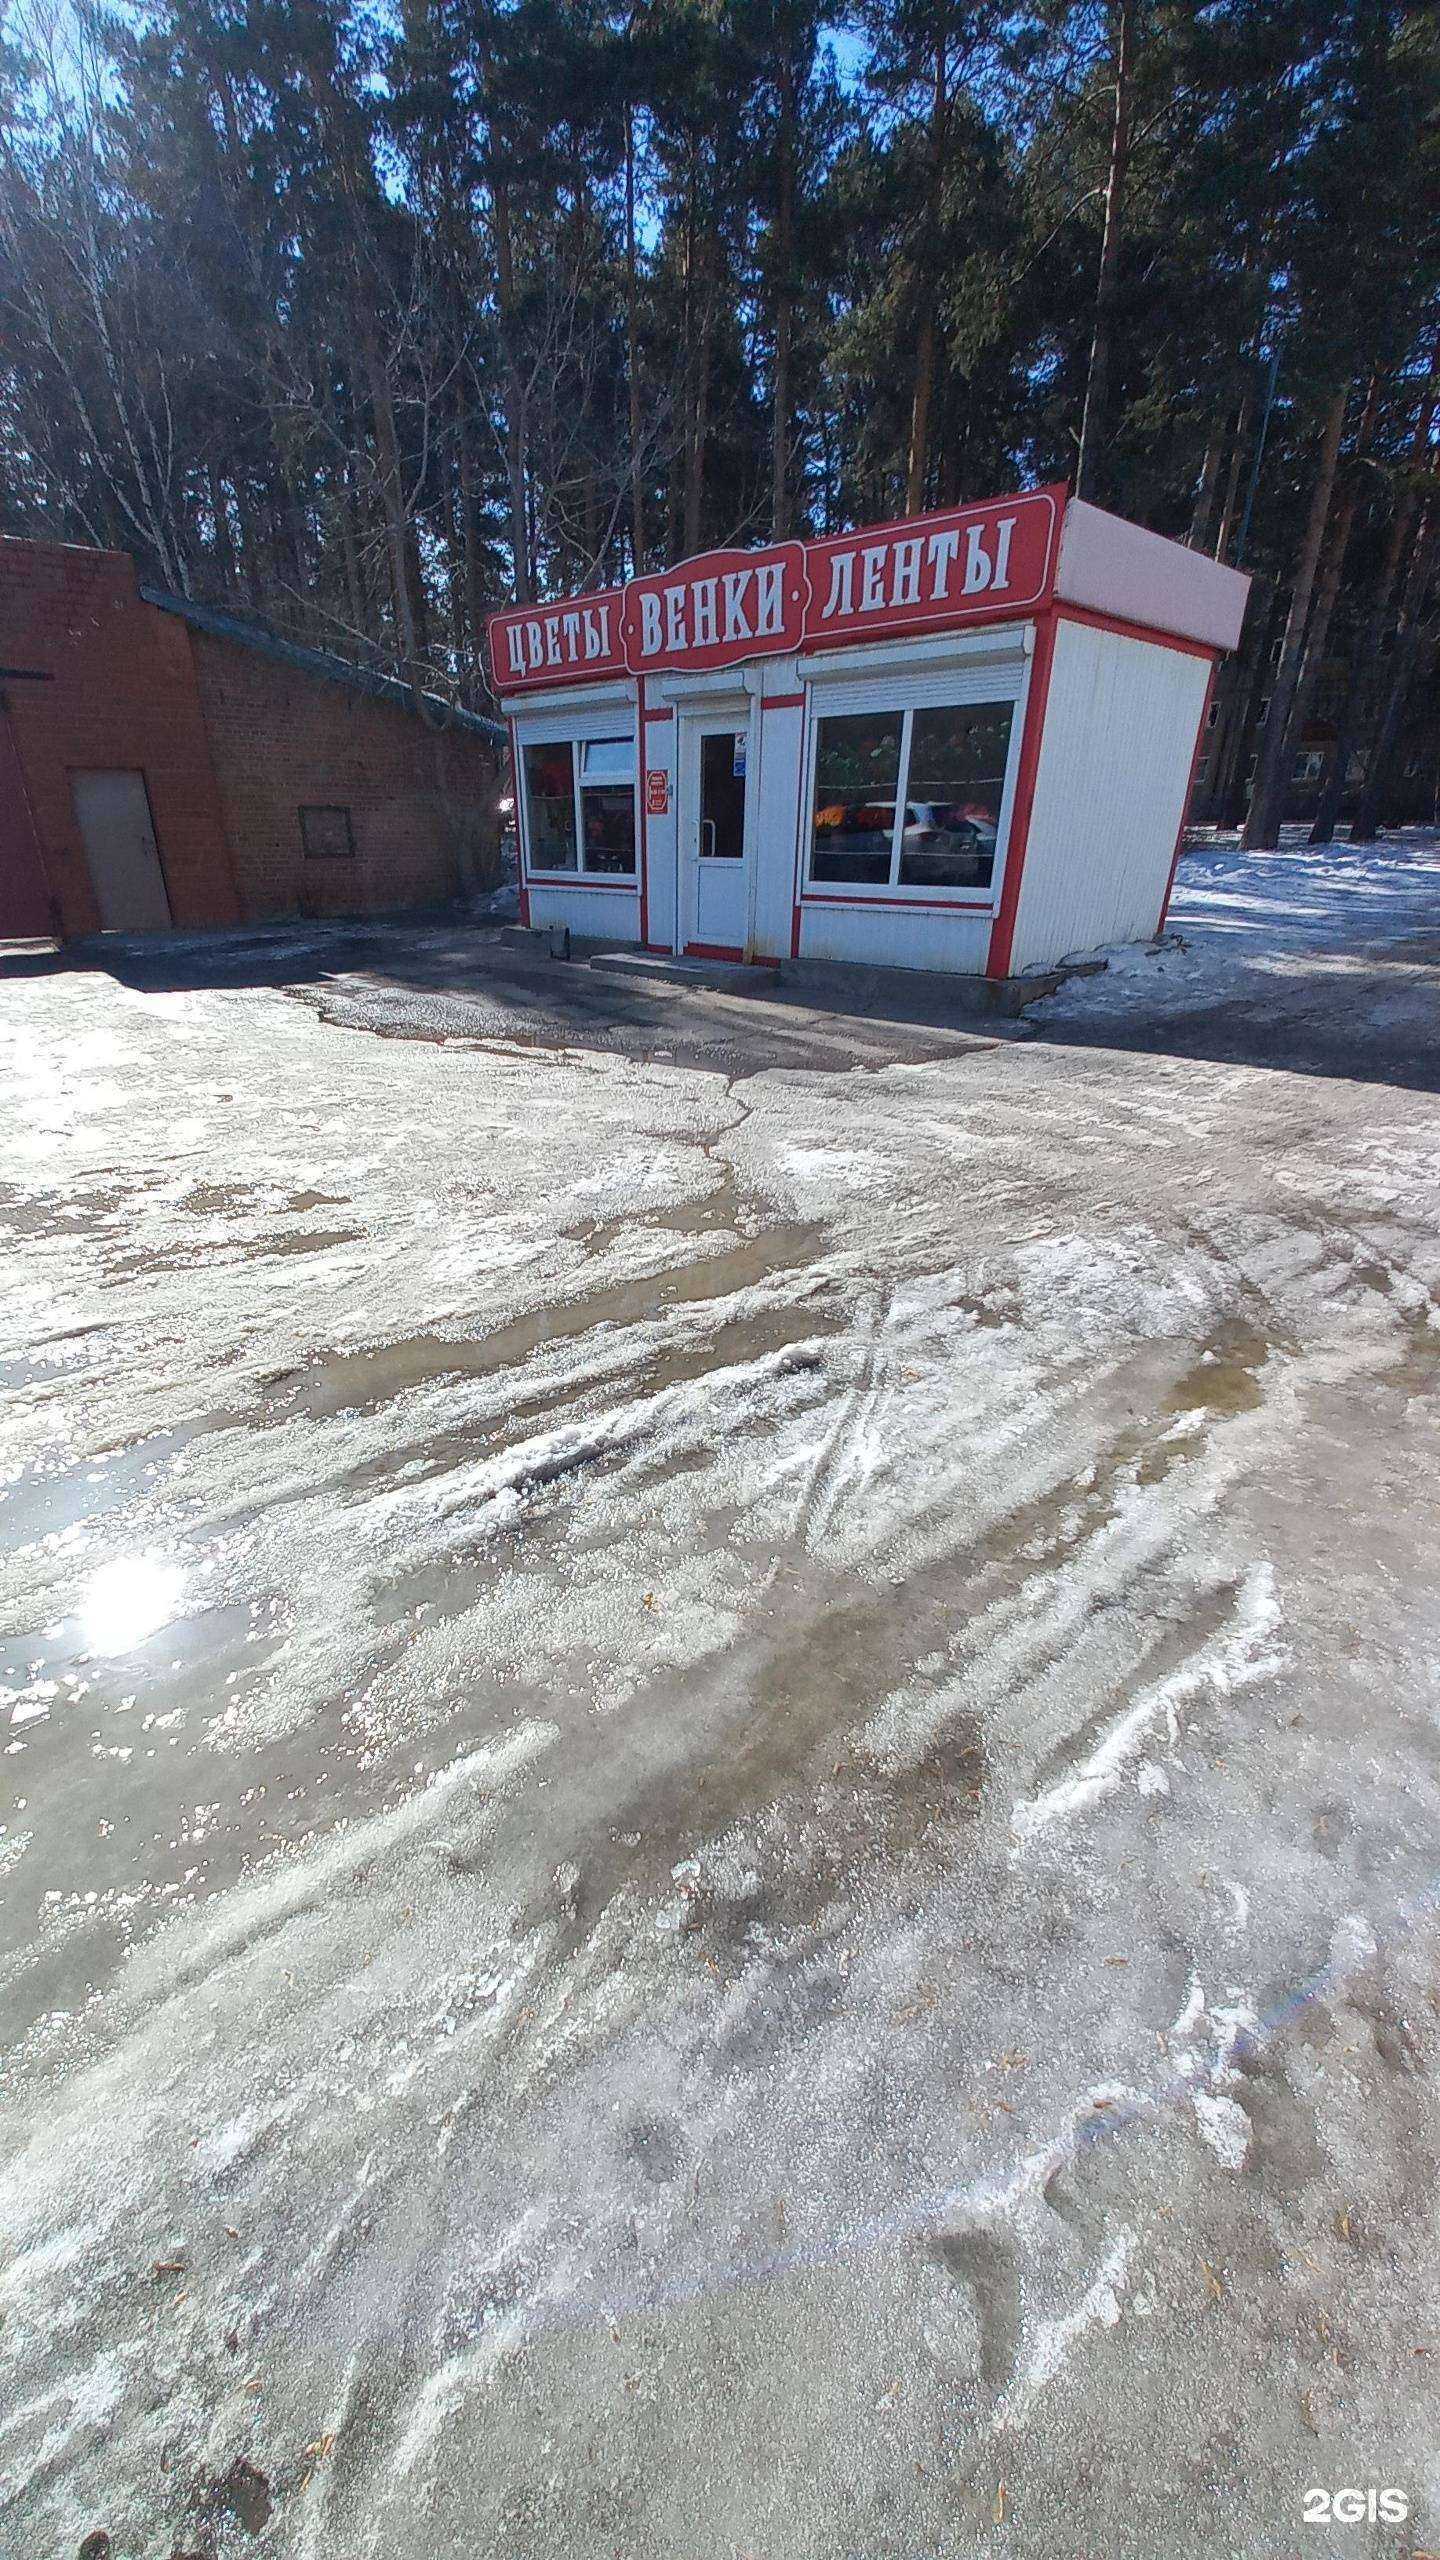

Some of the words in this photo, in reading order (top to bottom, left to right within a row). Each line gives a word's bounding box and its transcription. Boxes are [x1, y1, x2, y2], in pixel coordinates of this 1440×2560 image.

[506, 605, 611, 676] ЦВЕТЫ
[639, 562, 786, 657] ВЕНКИ
[821, 516, 1017, 619] ЛЕНТЫ
